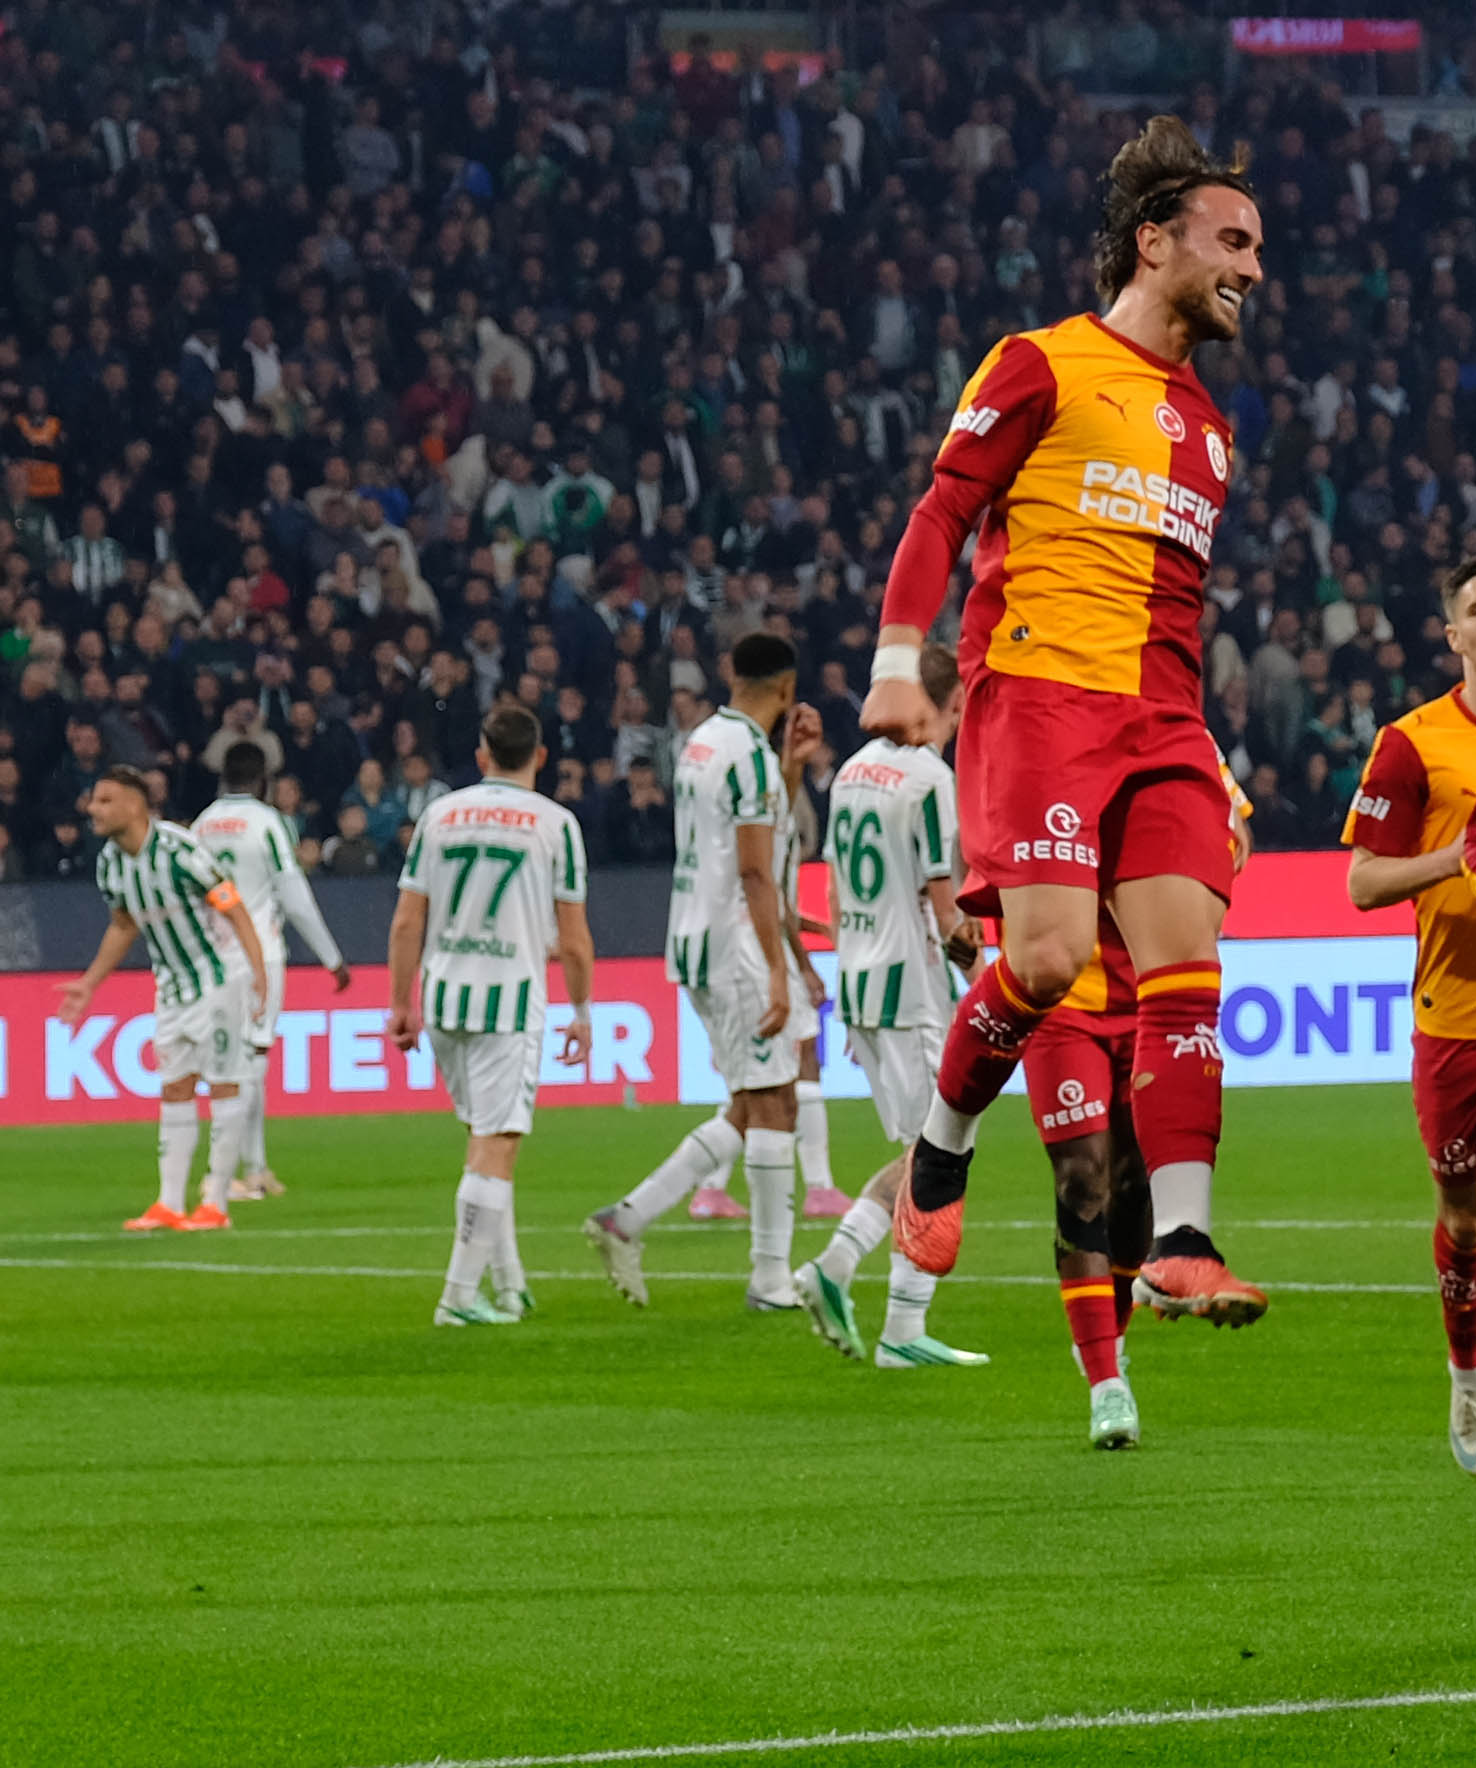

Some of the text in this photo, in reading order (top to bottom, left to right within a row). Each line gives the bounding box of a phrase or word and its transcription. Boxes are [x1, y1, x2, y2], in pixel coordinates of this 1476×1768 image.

[1014, 840, 1099, 868] REGES
[443, 844, 526, 930] 77
[1042, 1100, 1106, 1129] REGES
